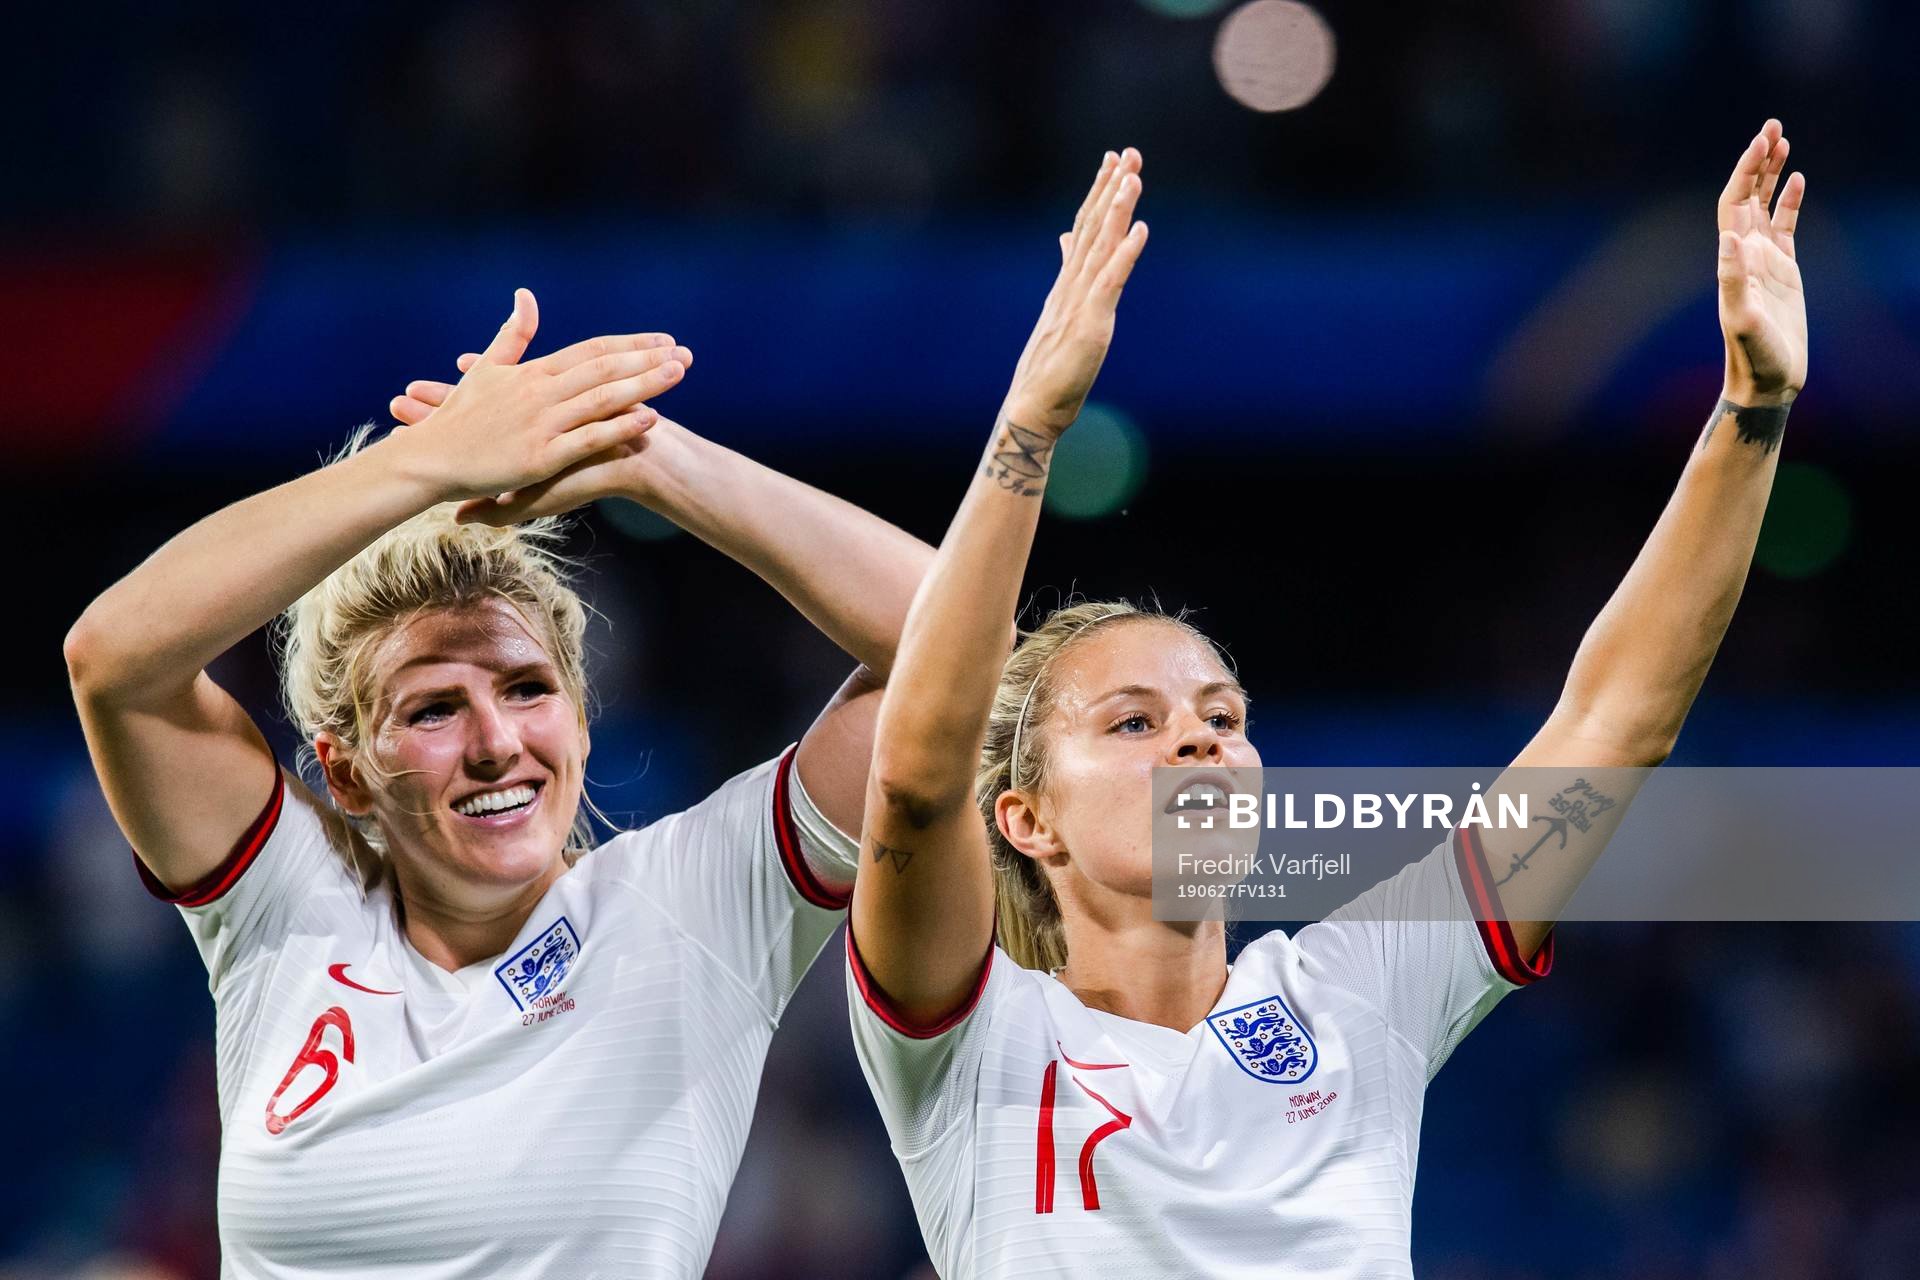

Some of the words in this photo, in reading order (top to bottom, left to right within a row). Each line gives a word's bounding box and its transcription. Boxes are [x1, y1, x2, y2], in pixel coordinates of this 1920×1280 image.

[1548, 793, 1593, 834] REFUSE
[522, 1013, 535, 1026] 27
[537, 1007, 557, 1023] JUNE
[556, 998, 575, 1015] 2019
[265, 1005, 355, 1135] 6
[1285, 1111, 1296, 1124] 27
[1297, 1105, 1319, 1121] JUNE
[1317, 1091, 1337, 1110] 2019
[1288, 1090, 1322, 1108] NORWAY
[1035, 1060, 1132, 1214] 17
